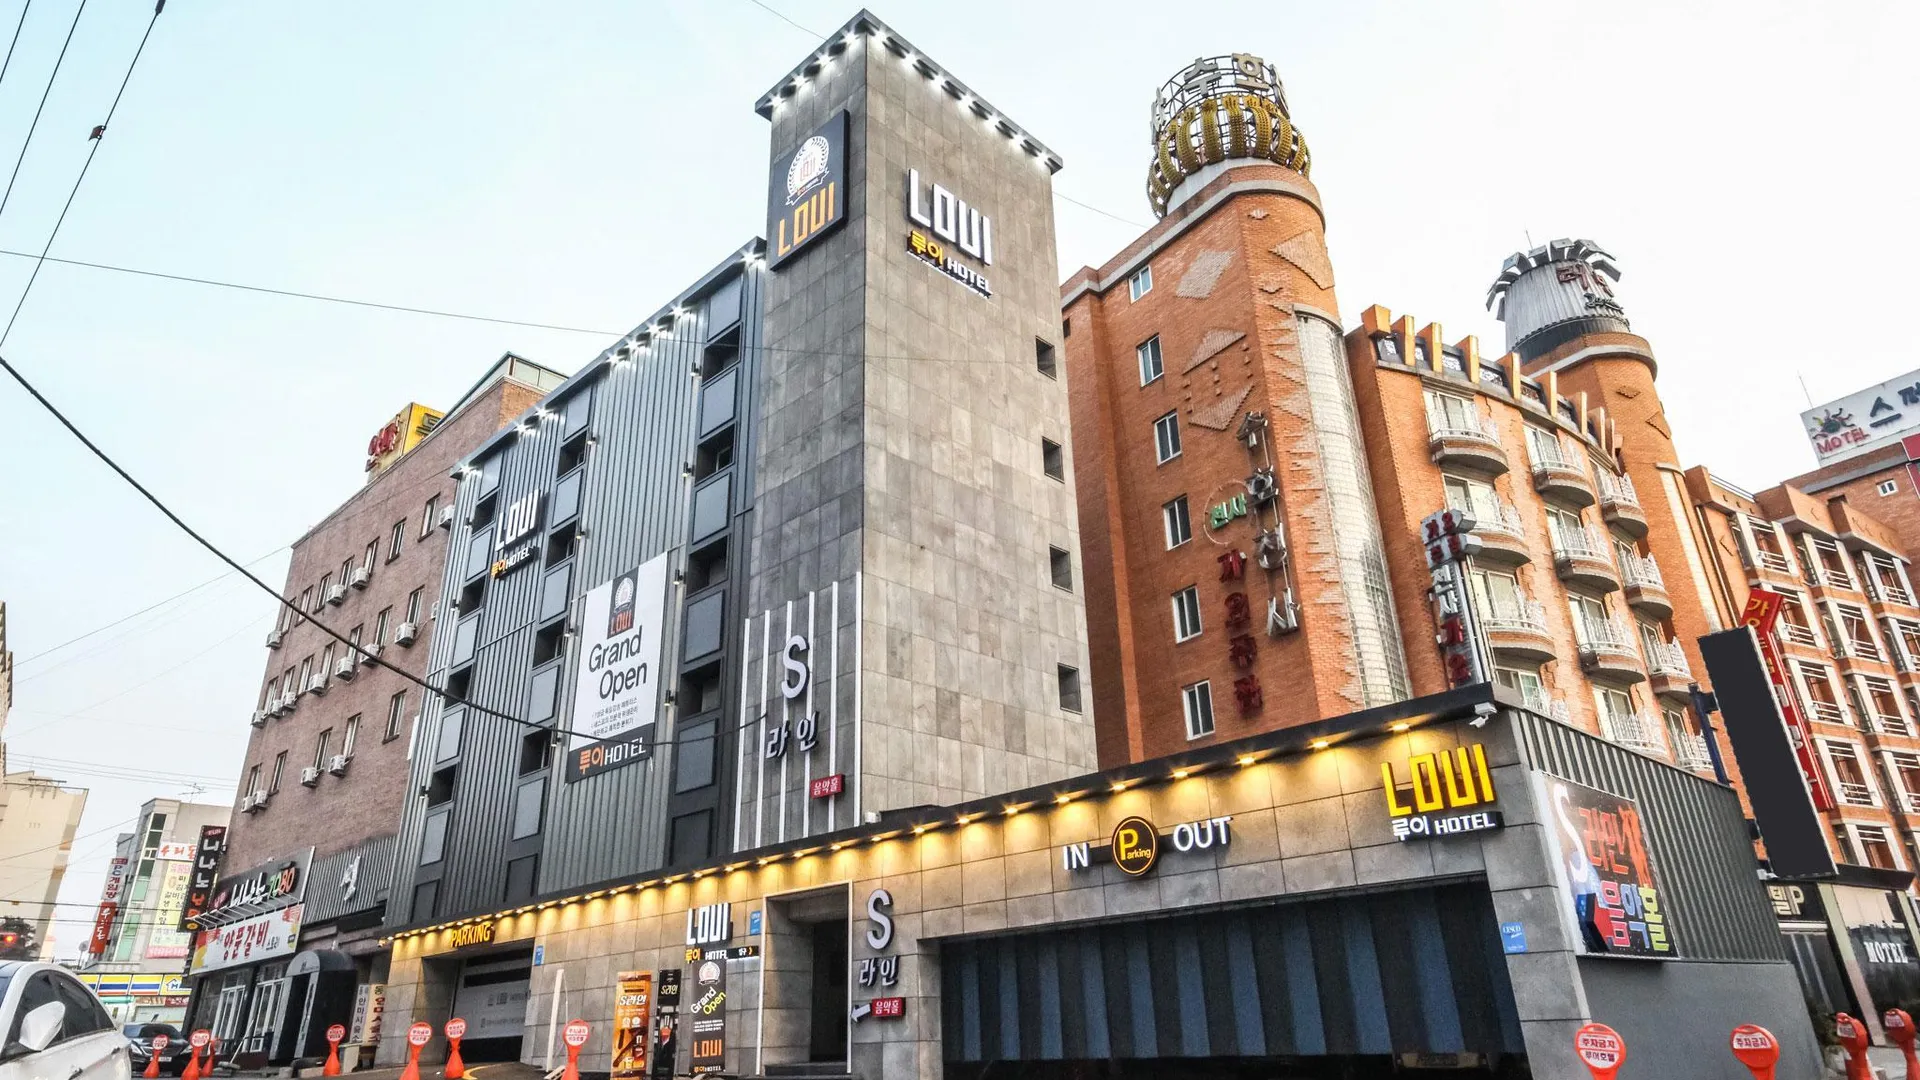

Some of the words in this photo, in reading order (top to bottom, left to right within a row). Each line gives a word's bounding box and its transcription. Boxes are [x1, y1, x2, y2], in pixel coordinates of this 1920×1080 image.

[778, 181, 835, 257] LOUI
[909, 168, 992, 266] LOUI
[912, 230, 943, 265] 루이
[947, 257, 993, 294] HOTEL
[1816, 428, 1870, 454] MOTEL
[495, 488, 539, 552] LOUI
[506, 547, 530, 569] HOTEL
[589, 625, 642, 672] Grand
[781, 635, 809, 699] S
[600, 662, 648, 701] Open
[766, 711, 818, 759] 라인
[579, 745, 604, 775] 루이
[604, 737, 646, 765] HOTEL
[1381, 743, 1495, 817] LOUI
[1118, 828, 1151, 861] Parking
[1172, 816, 1232, 851] OUT
[1391, 815, 1430, 841] 루이
[1434, 812, 1496, 835] HOTEL
[1554, 783, 1588, 882] S
[1579, 806, 1629, 876] 라인
[1062, 843, 1089, 870] IN
[450, 923, 491, 948] PARKING
[686, 902, 729, 945] LOUI
[866, 889, 890, 949] S
[859, 955, 898, 986] 라인
[1863, 941, 1908, 964] MOTEL
[690, 986, 717, 1014] Grand
[703, 991, 727, 1015] Open
[693, 1039, 722, 1058] LOUI
[1582, 1038, 1616, 1048] 주차금지
